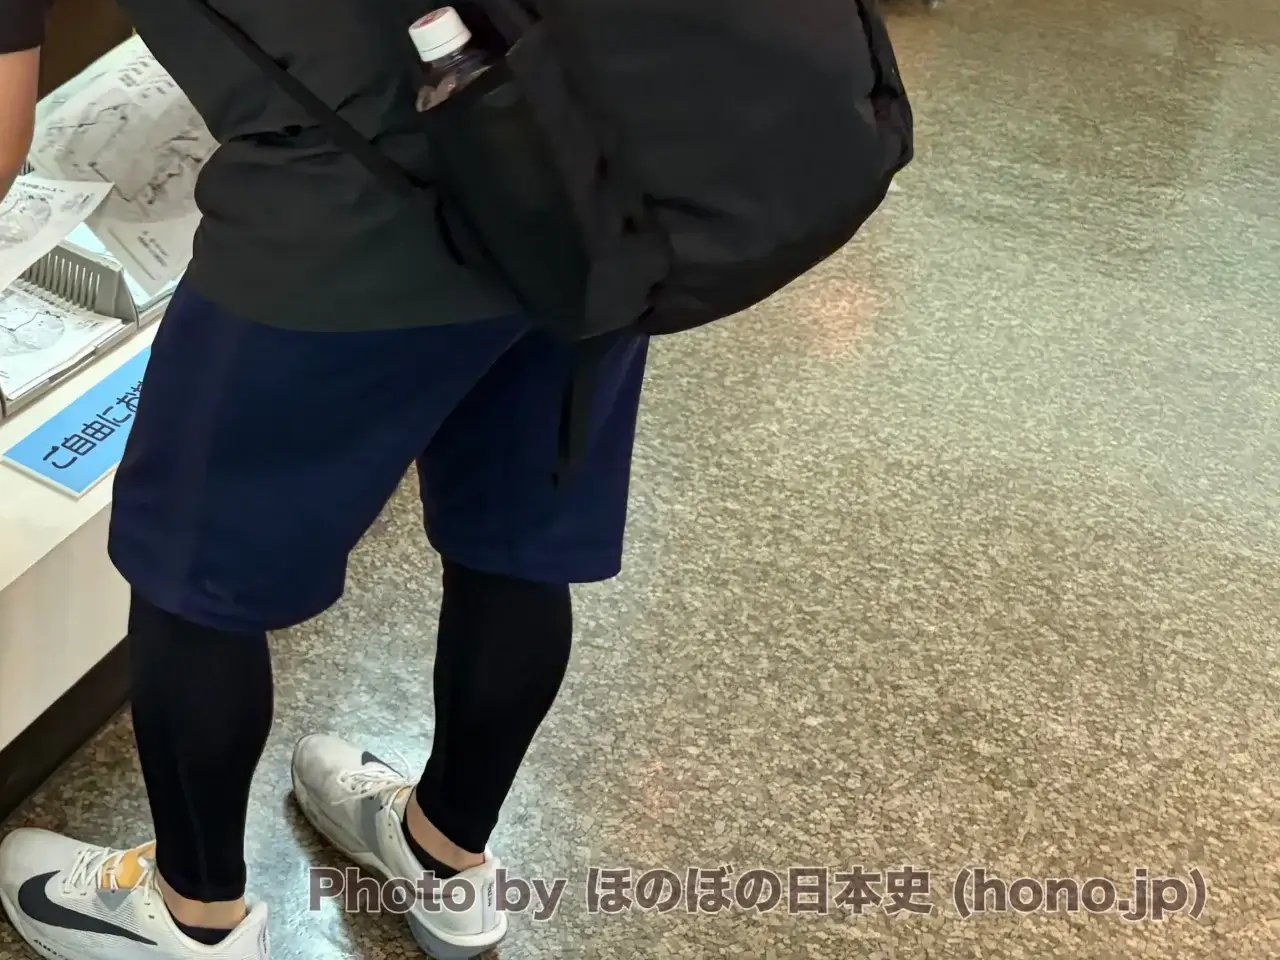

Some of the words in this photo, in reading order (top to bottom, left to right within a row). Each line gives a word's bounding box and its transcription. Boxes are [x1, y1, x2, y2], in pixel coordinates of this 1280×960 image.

[43, 381, 141, 469] ご自由にお
